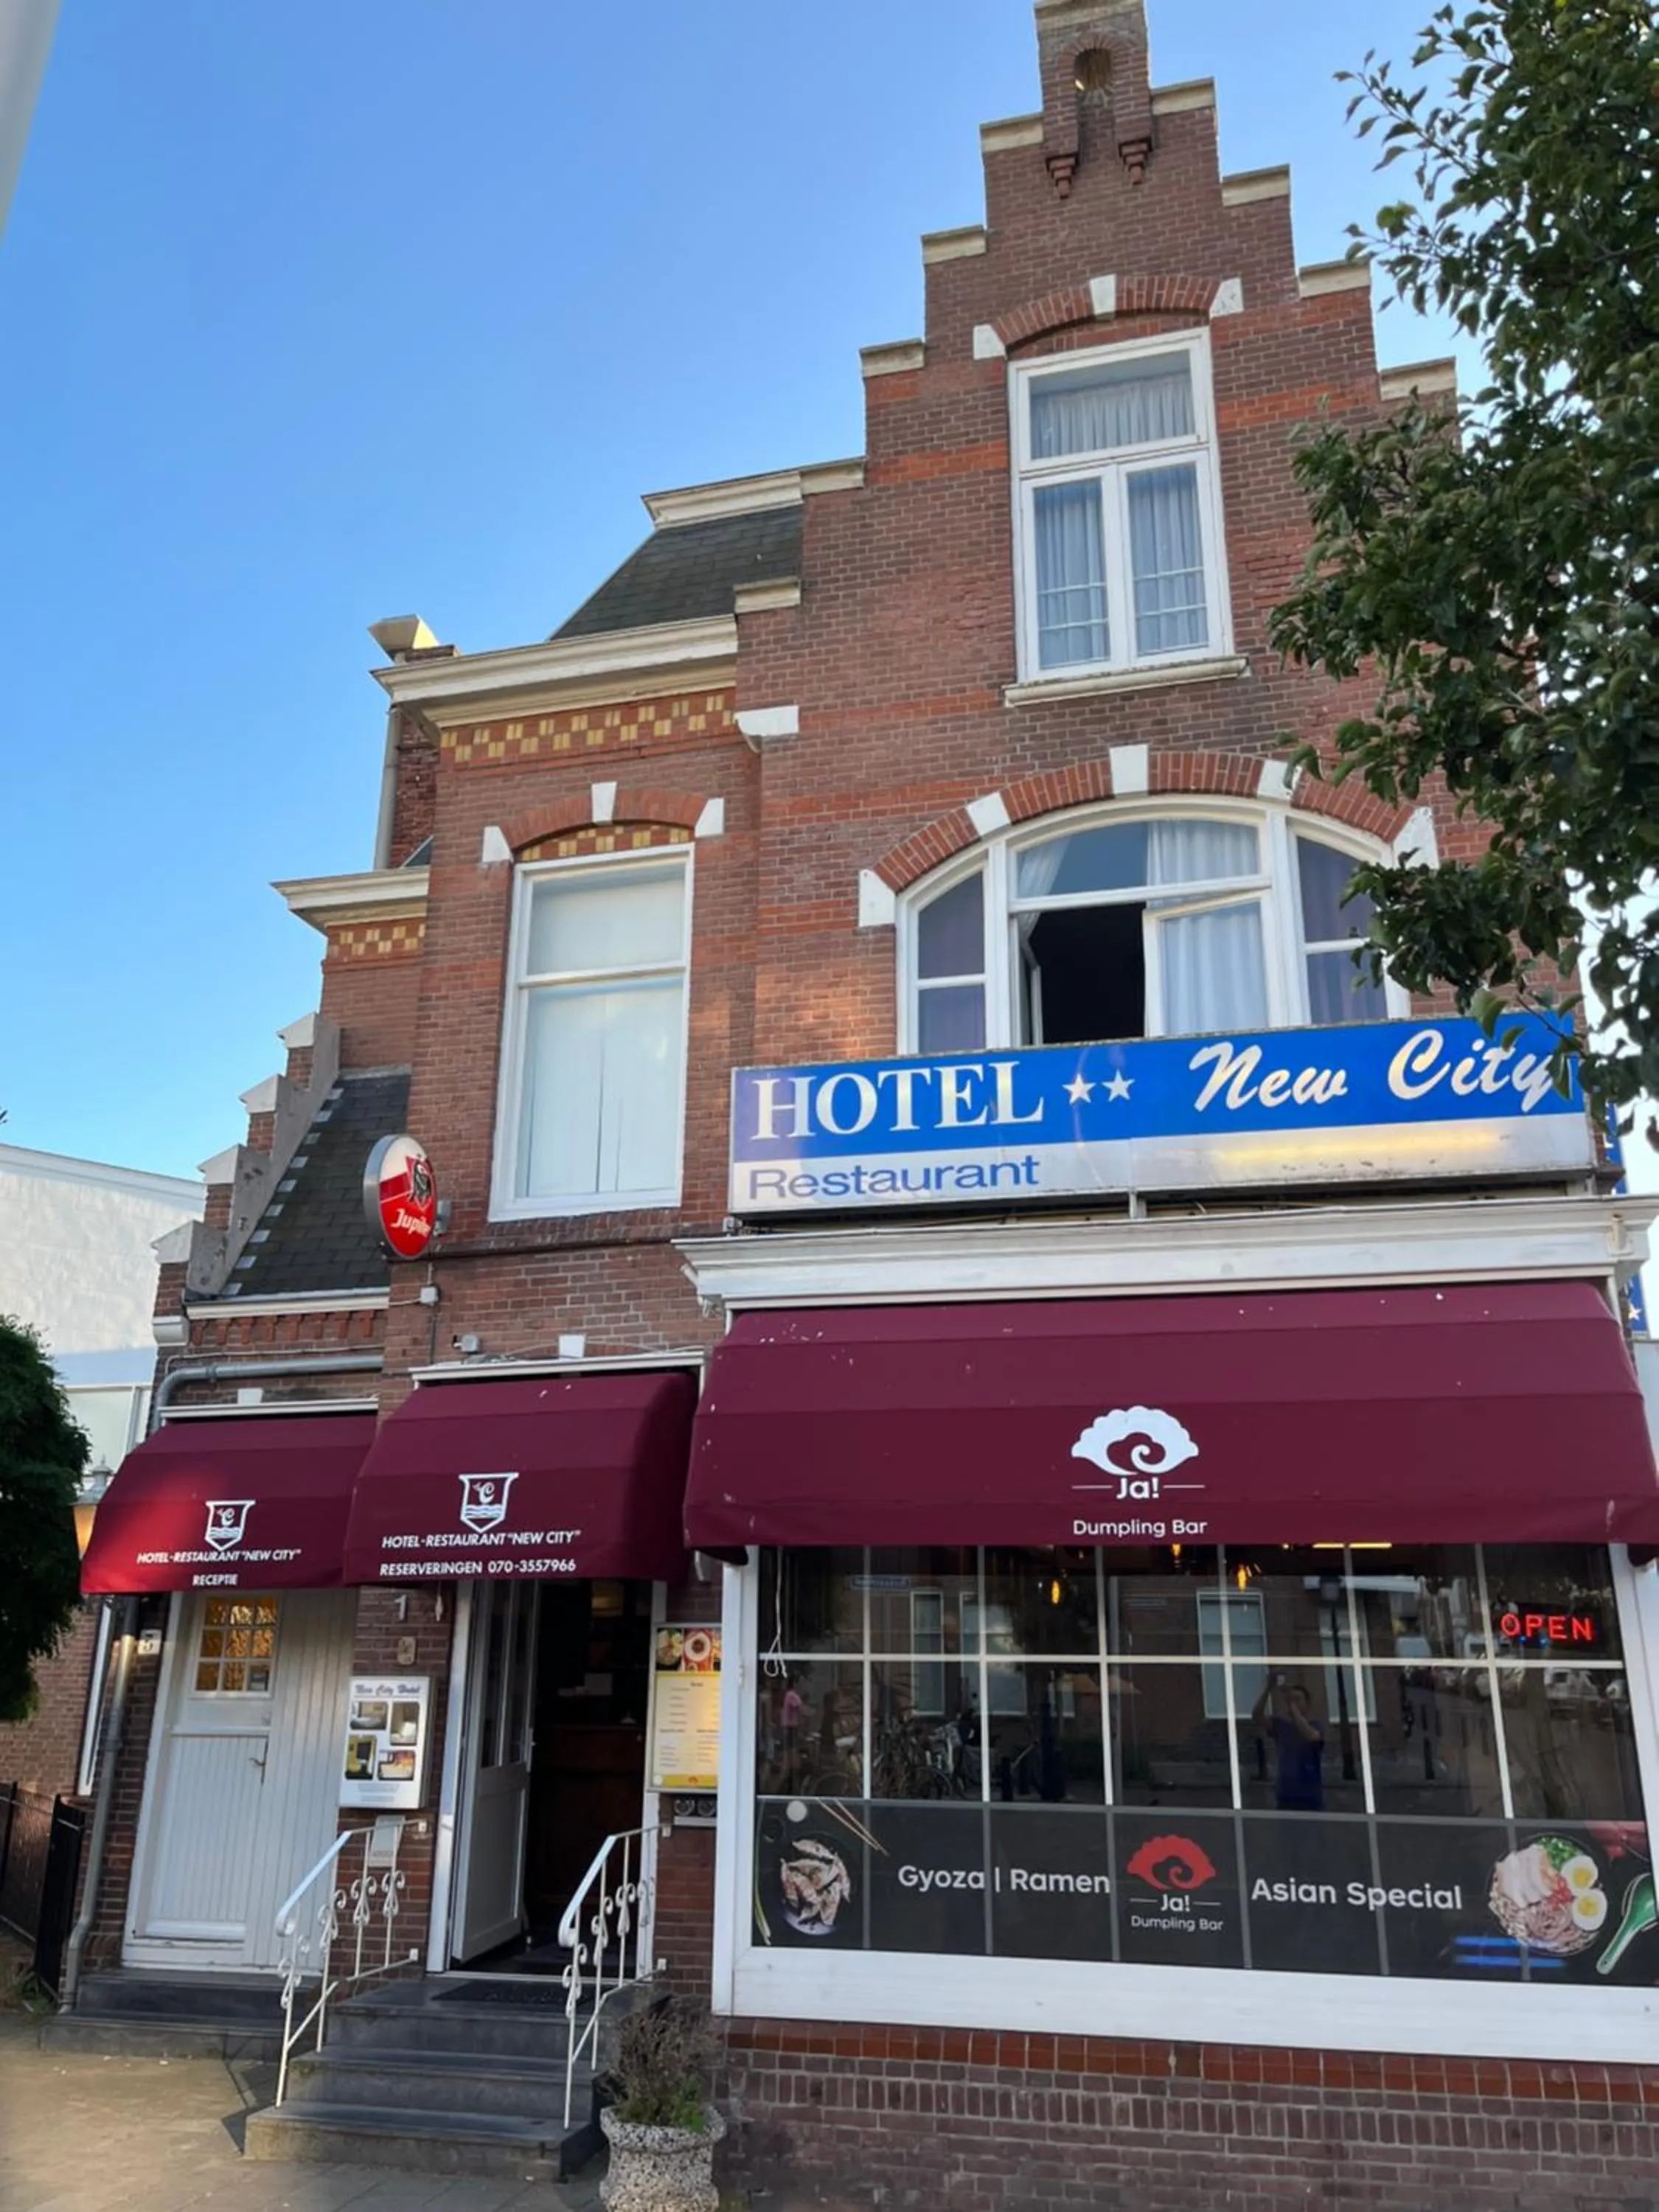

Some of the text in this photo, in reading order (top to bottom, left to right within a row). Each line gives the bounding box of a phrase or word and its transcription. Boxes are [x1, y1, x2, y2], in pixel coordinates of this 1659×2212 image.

[751, 1029, 1554, 1140] HOTEL New City
[749, 1155, 1040, 1200] Restaurant
[1116, 1477, 1160, 1500] Ja!
[1073, 1519, 1208, 1537] Dumpling Bar
[382, 1533, 504, 1548] HOTEL-RESTAURANT
[137, 1551, 239, 1564] HOTEL-RESTAURANT
[380, 1559, 577, 1576] RESERVERINGEN 070-3557966
[192, 1573, 238, 1586] RECEPTIE
[1500, 1613, 1593, 1641] OPEN
[897, 1865, 985, 1893] Gyoza
[1010, 1868, 1111, 1894] Ramen
[1160, 1893, 1191, 1912] Ja!
[1251, 1877, 1463, 1911] Asian Special
[1131, 1915, 1223, 1932] Dumpling Bar
